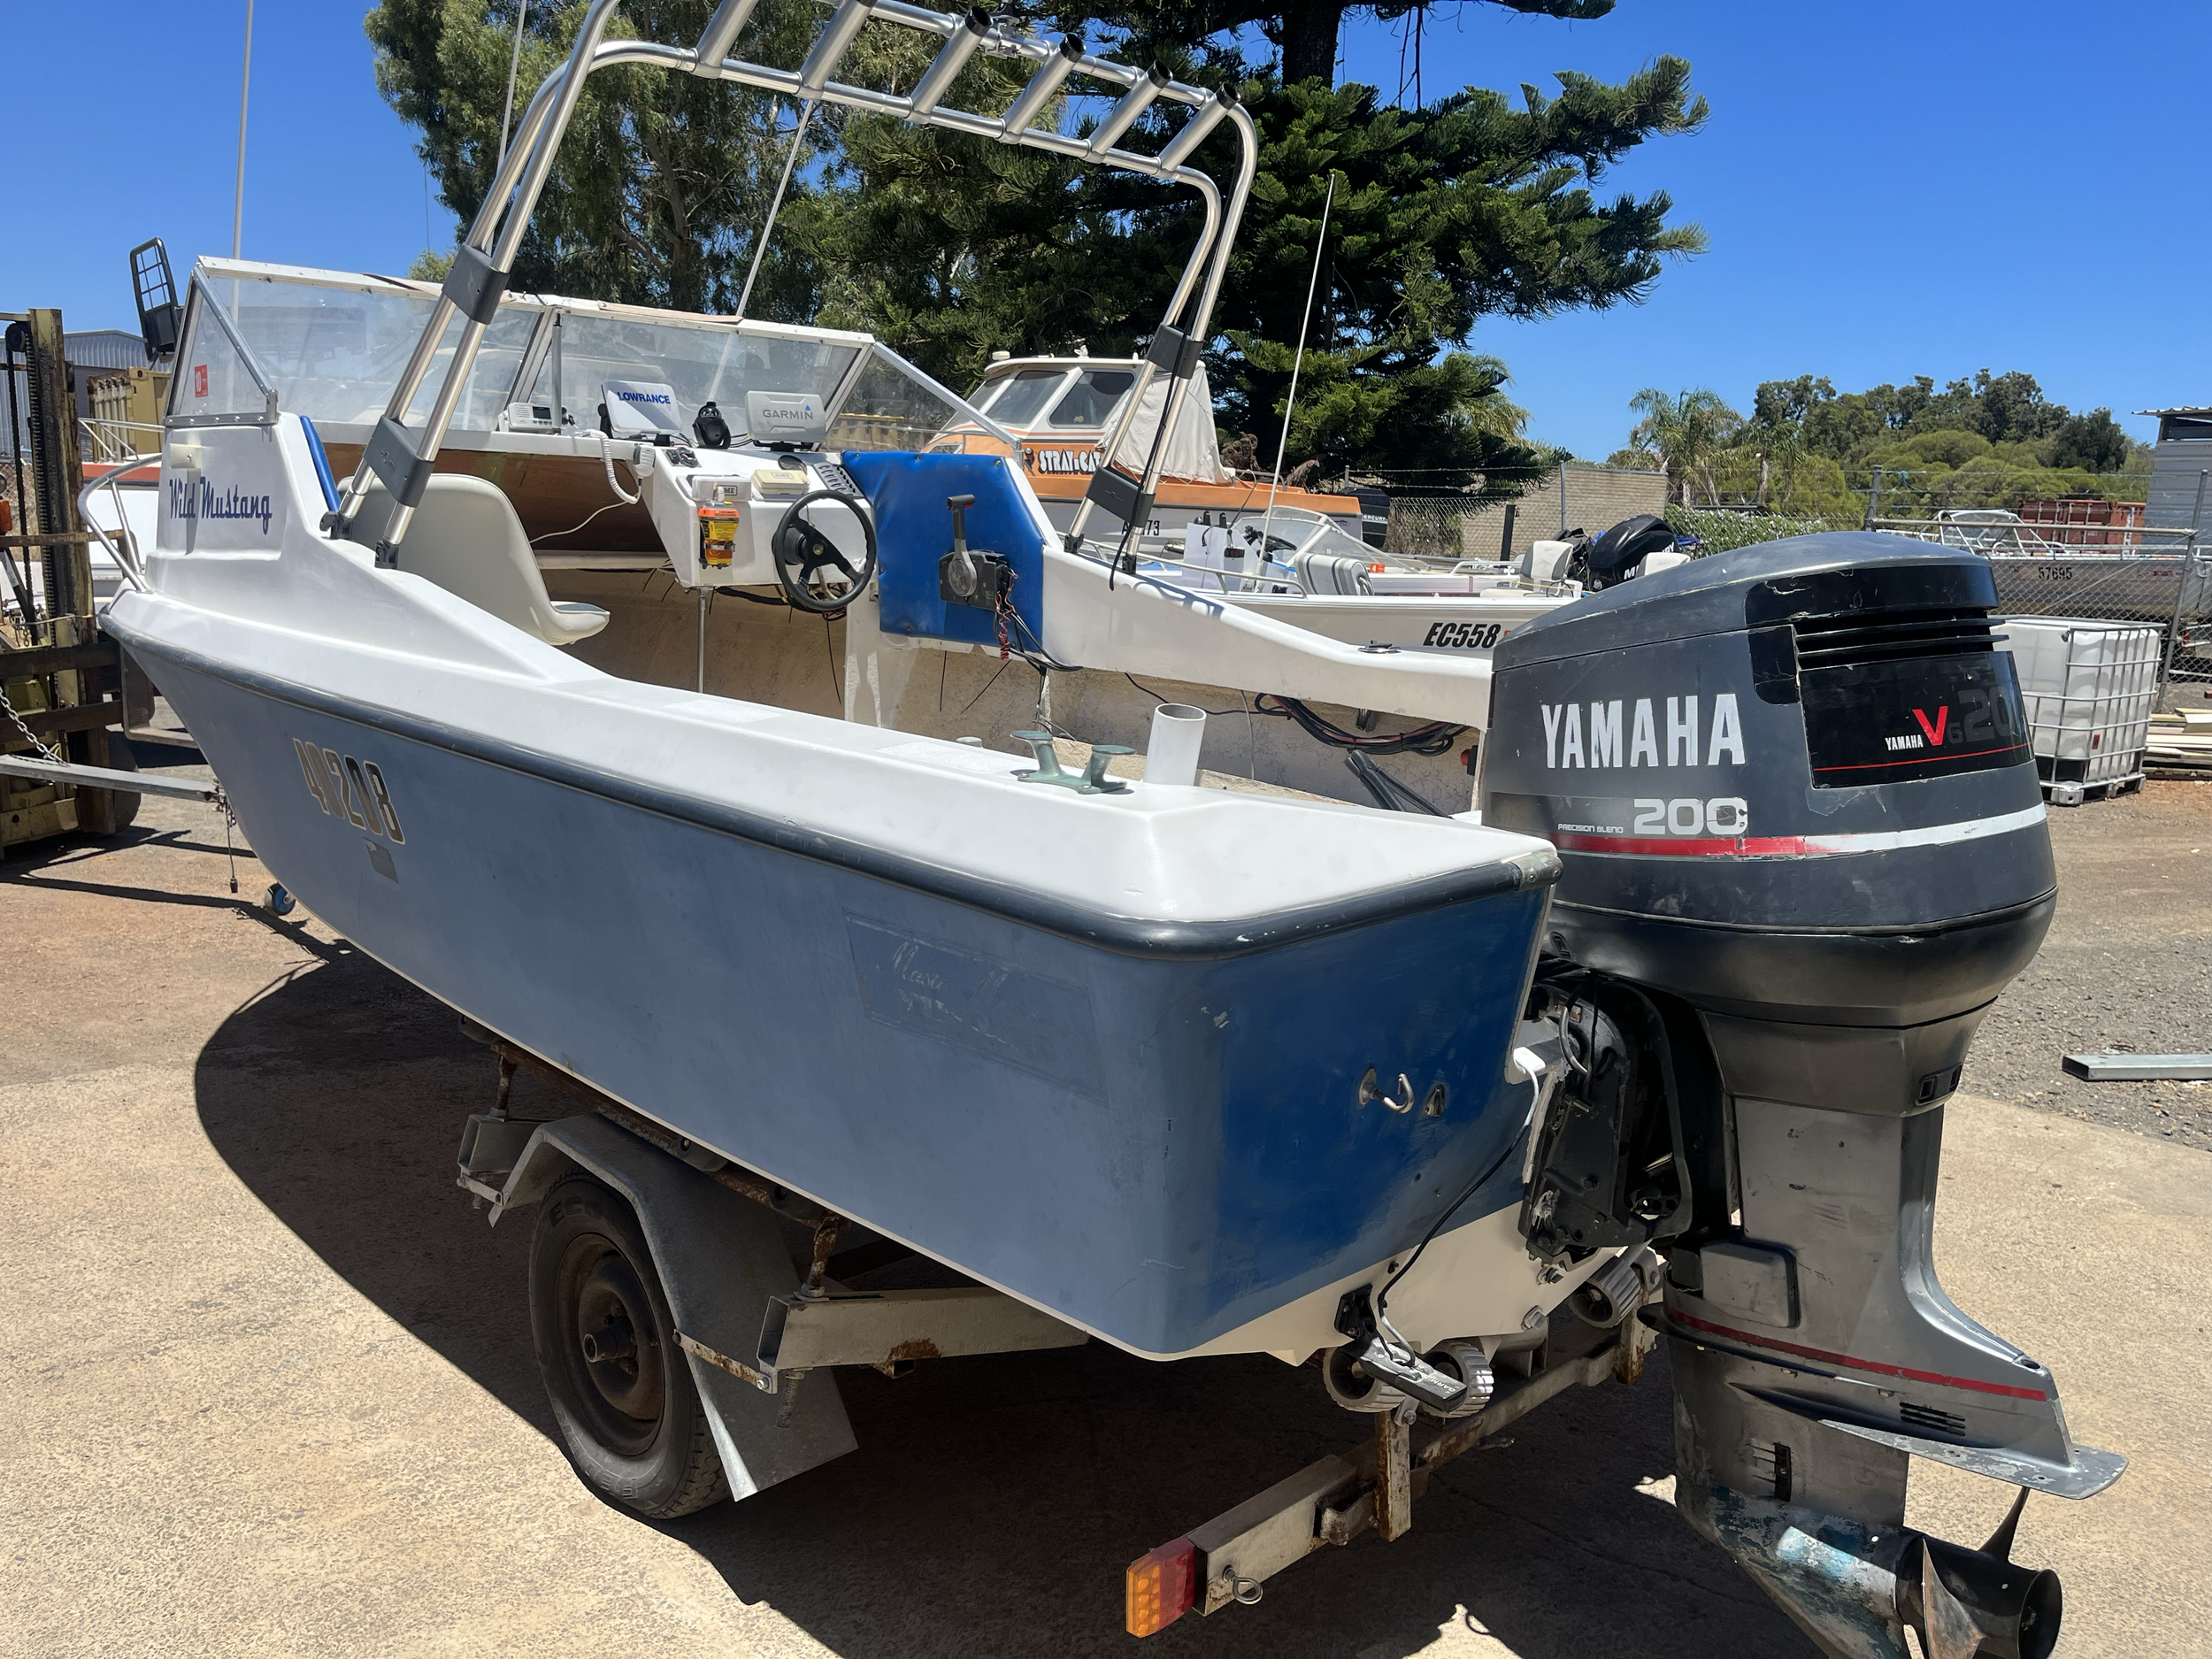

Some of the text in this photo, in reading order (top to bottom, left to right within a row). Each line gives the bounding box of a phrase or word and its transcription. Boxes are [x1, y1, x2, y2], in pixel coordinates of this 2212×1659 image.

[617, 391, 671, 405] LOWRANCE
[762, 408, 814, 420] GARMIN
[169, 476, 273, 535] Wild Mustang
[1121, 519, 1160, 536] A73
[2038, 566, 2072, 580] 57695
[1423, 622, 1502, 649] EC558
[1540, 693, 1747, 769] YAMAHA
[1885, 734, 1924, 751] YAMAHA
[1633, 797, 1748, 835] 200
[1557, 823, 1595, 833] PRECISION
